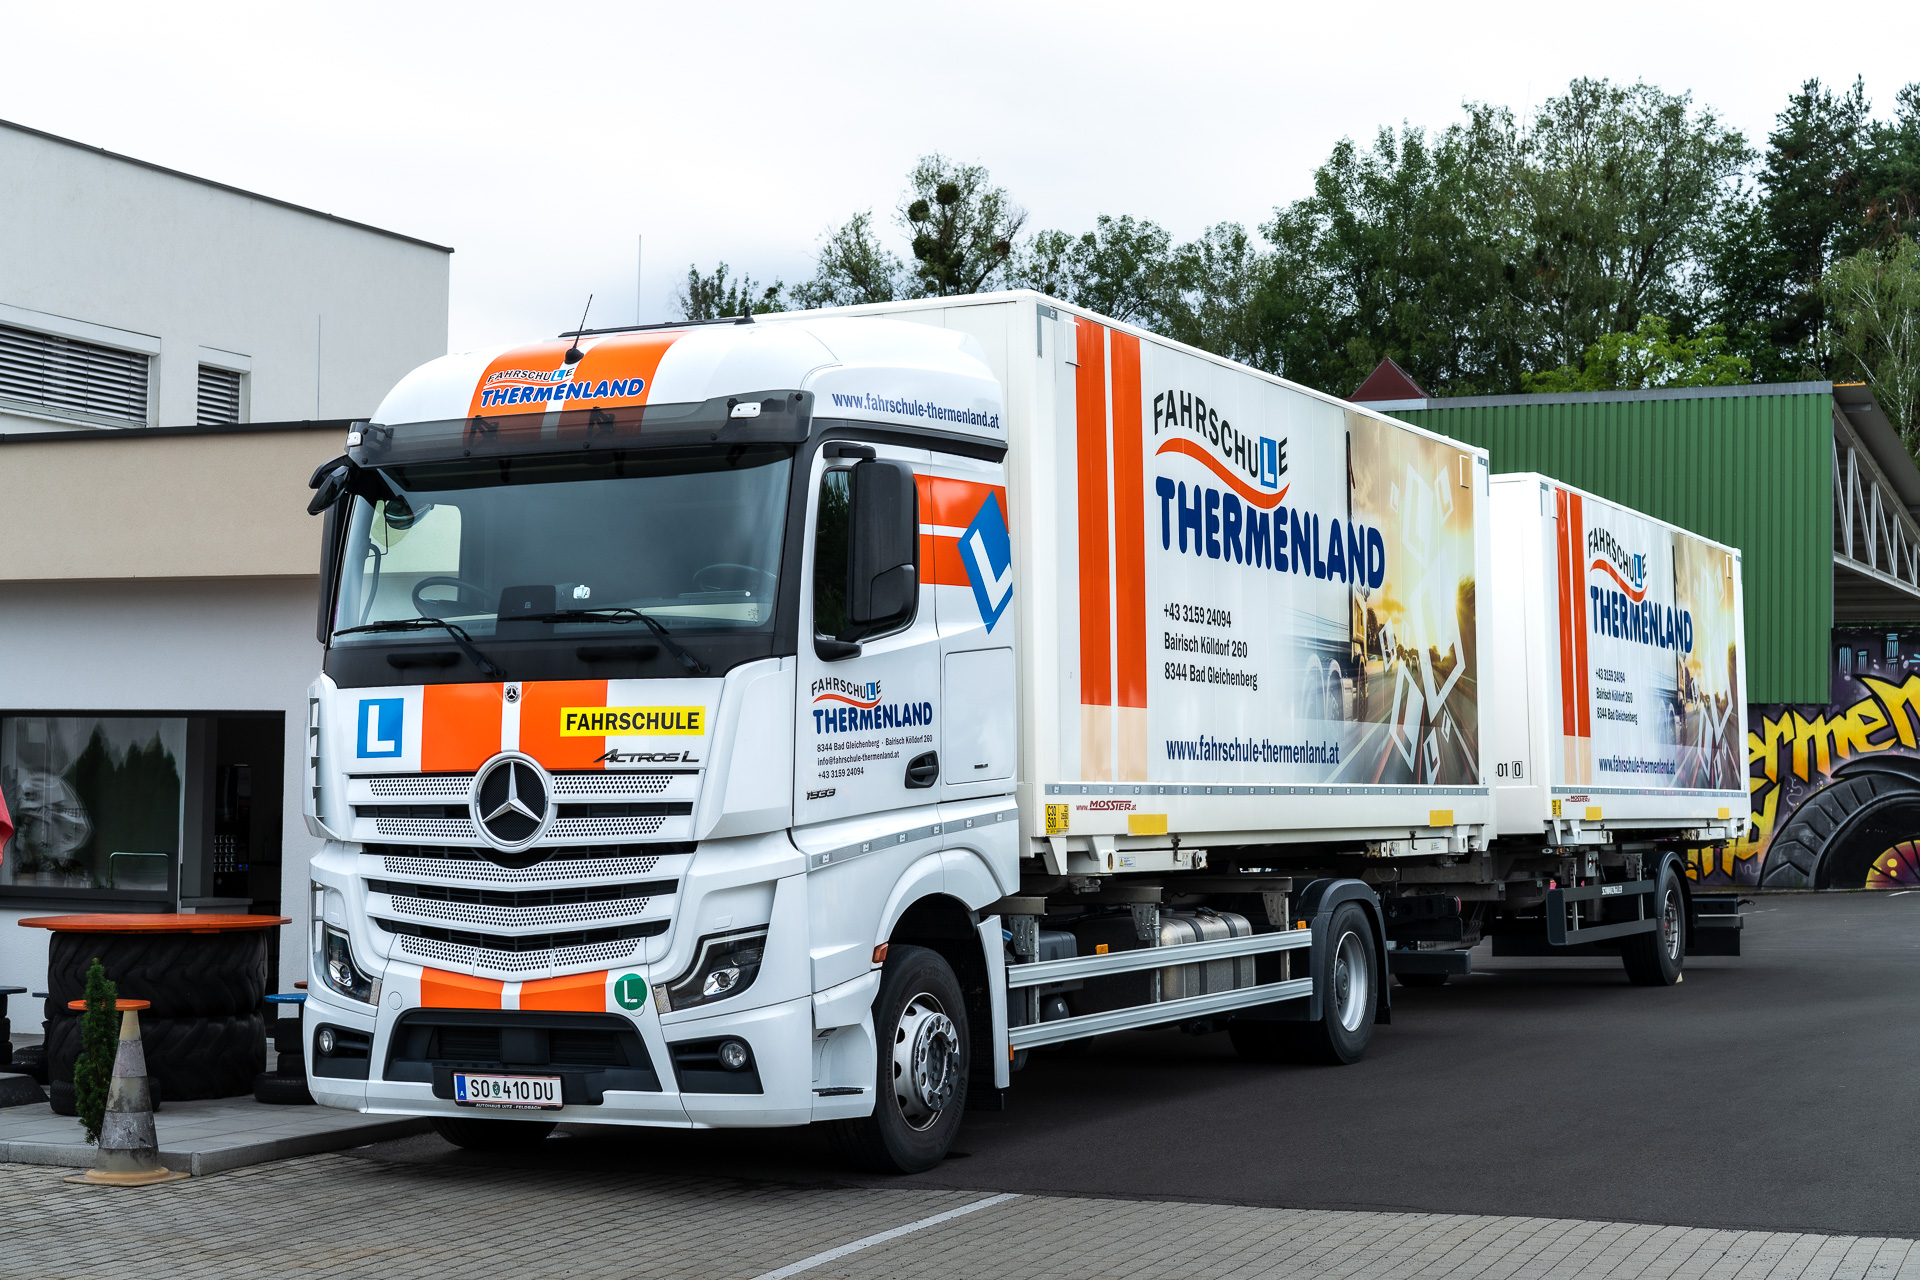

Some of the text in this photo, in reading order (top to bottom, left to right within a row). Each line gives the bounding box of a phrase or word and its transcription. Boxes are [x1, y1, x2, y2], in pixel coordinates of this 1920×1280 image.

[487, 367, 574, 382] FAHRSCHULE
[481, 378, 645, 407] THERMENLAND
[831, 392, 1000, 429] www.fahrschule-thermenland.at
[1153, 389, 1288, 487] FAHRSCHULE
[1155, 475, 1386, 589] THERMENLAND
[969, 528, 1013, 613] L
[1588, 527, 1647, 587] FAHRSCHULE
[1164, 602, 1232, 628] +43 3159 24094
[1590, 585, 1693, 653] THERMENLAND
[1164, 631, 1248, 659] Bairisch Kölldorf 260
[811, 677, 882, 700] FAHRSCHULE
[1164, 661, 1258, 691] 8344 Bad Gleichenberg
[565, 711, 700, 731] FAHRSCHULE
[812, 702, 933, 734] THERMENLAND
[681, 750, 700, 763] L
[817, 742, 833, 752] 8344
[833, 741, 845, 751] Bad
[845, 739, 880, 749] Gleichenberg
[885, 737, 905, 746] Bairisch
[923, 734, 933, 743] 260
[1166, 734, 1340, 764] www.fahrschule-thermenland.at
[817, 750, 900, 766] info@fahrschule-thermenland.at
[818, 766, 864, 779] +43 3159 24094
[470, 1079, 553, 1100] SO 410 DU
